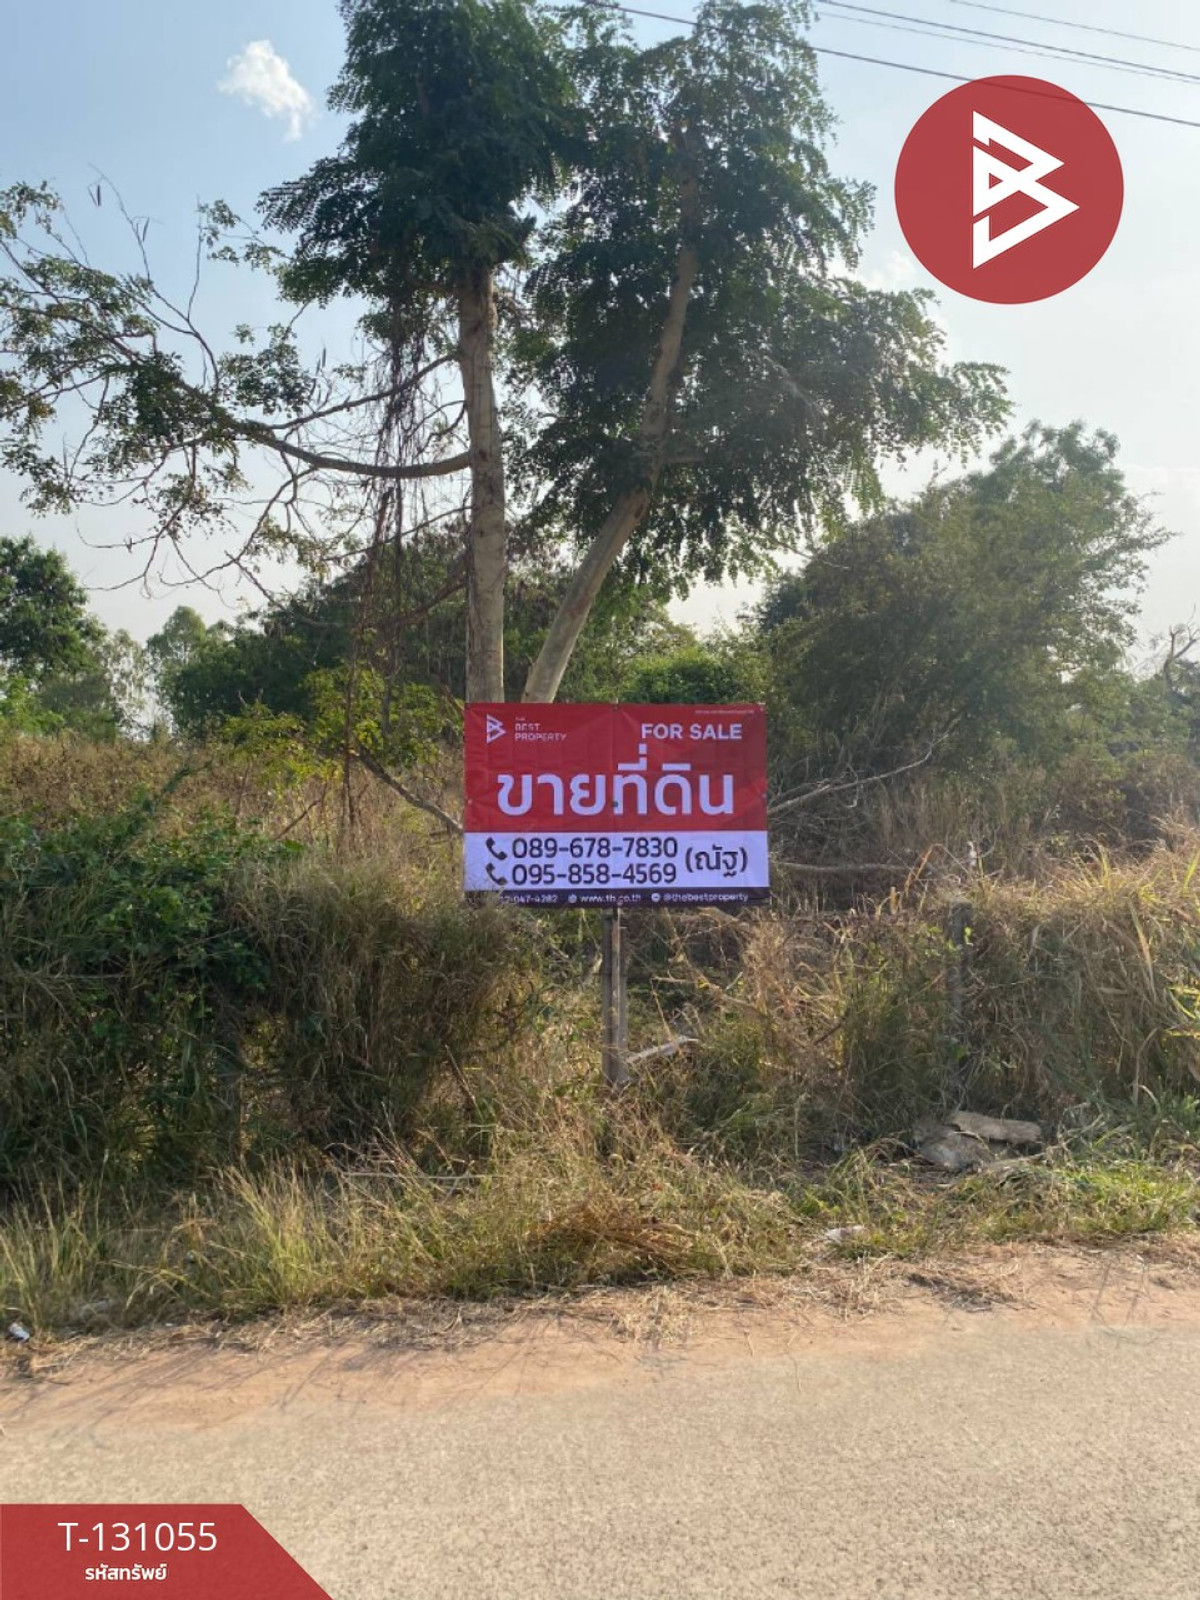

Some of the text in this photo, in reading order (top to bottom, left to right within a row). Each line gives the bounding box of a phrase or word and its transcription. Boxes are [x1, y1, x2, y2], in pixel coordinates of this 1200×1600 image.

[515, 733, 567, 741] PROPERTY
[641, 723, 743, 739] FOR SALE
[497, 743, 735, 816] ขายที่ดิน
[511, 837, 678, 859] 089-678-7830
[685, 844, 748, 877] (ณัฐ)
[511, 863, 677, 885] 095-858-4569
